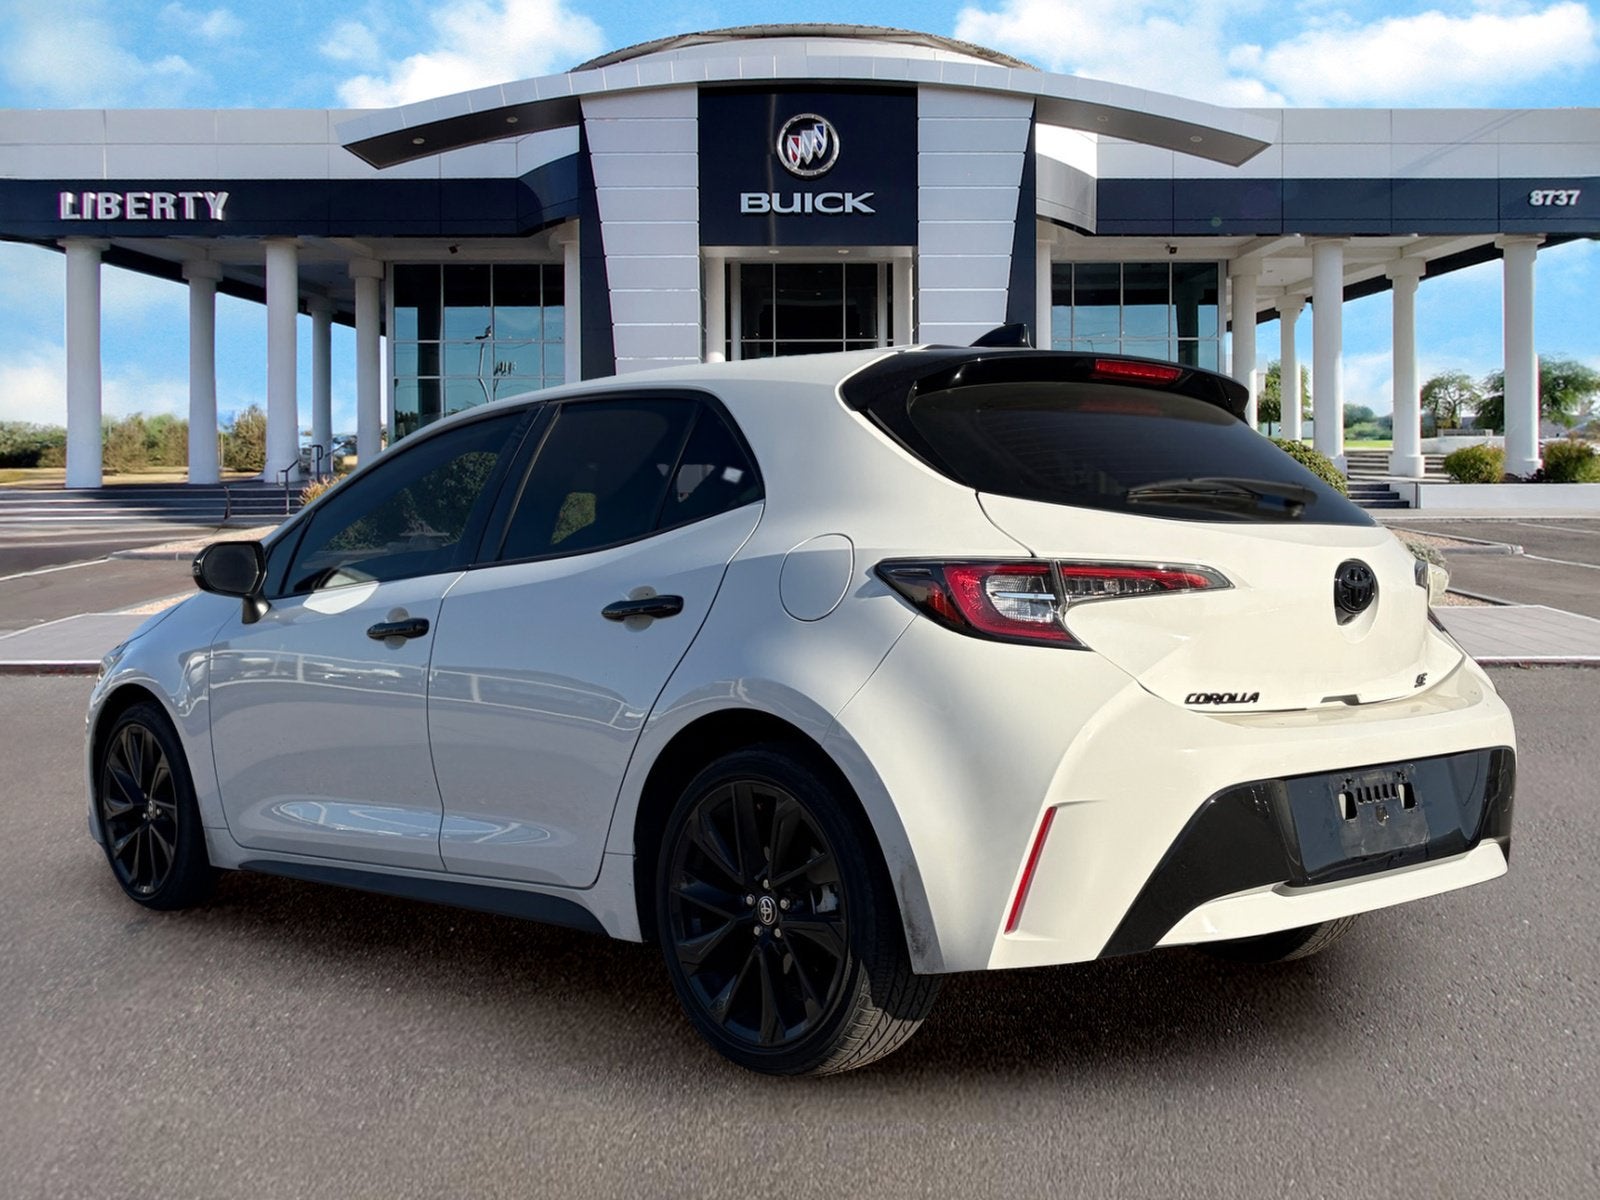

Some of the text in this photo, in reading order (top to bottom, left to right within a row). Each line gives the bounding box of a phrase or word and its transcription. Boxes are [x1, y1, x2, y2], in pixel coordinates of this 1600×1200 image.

[59, 191, 229, 220] LIBERTY
[740, 192, 876, 213] BUICK
[1529, 189, 1581, 206] 8737
[1184, 692, 1260, 705] COROLLA
